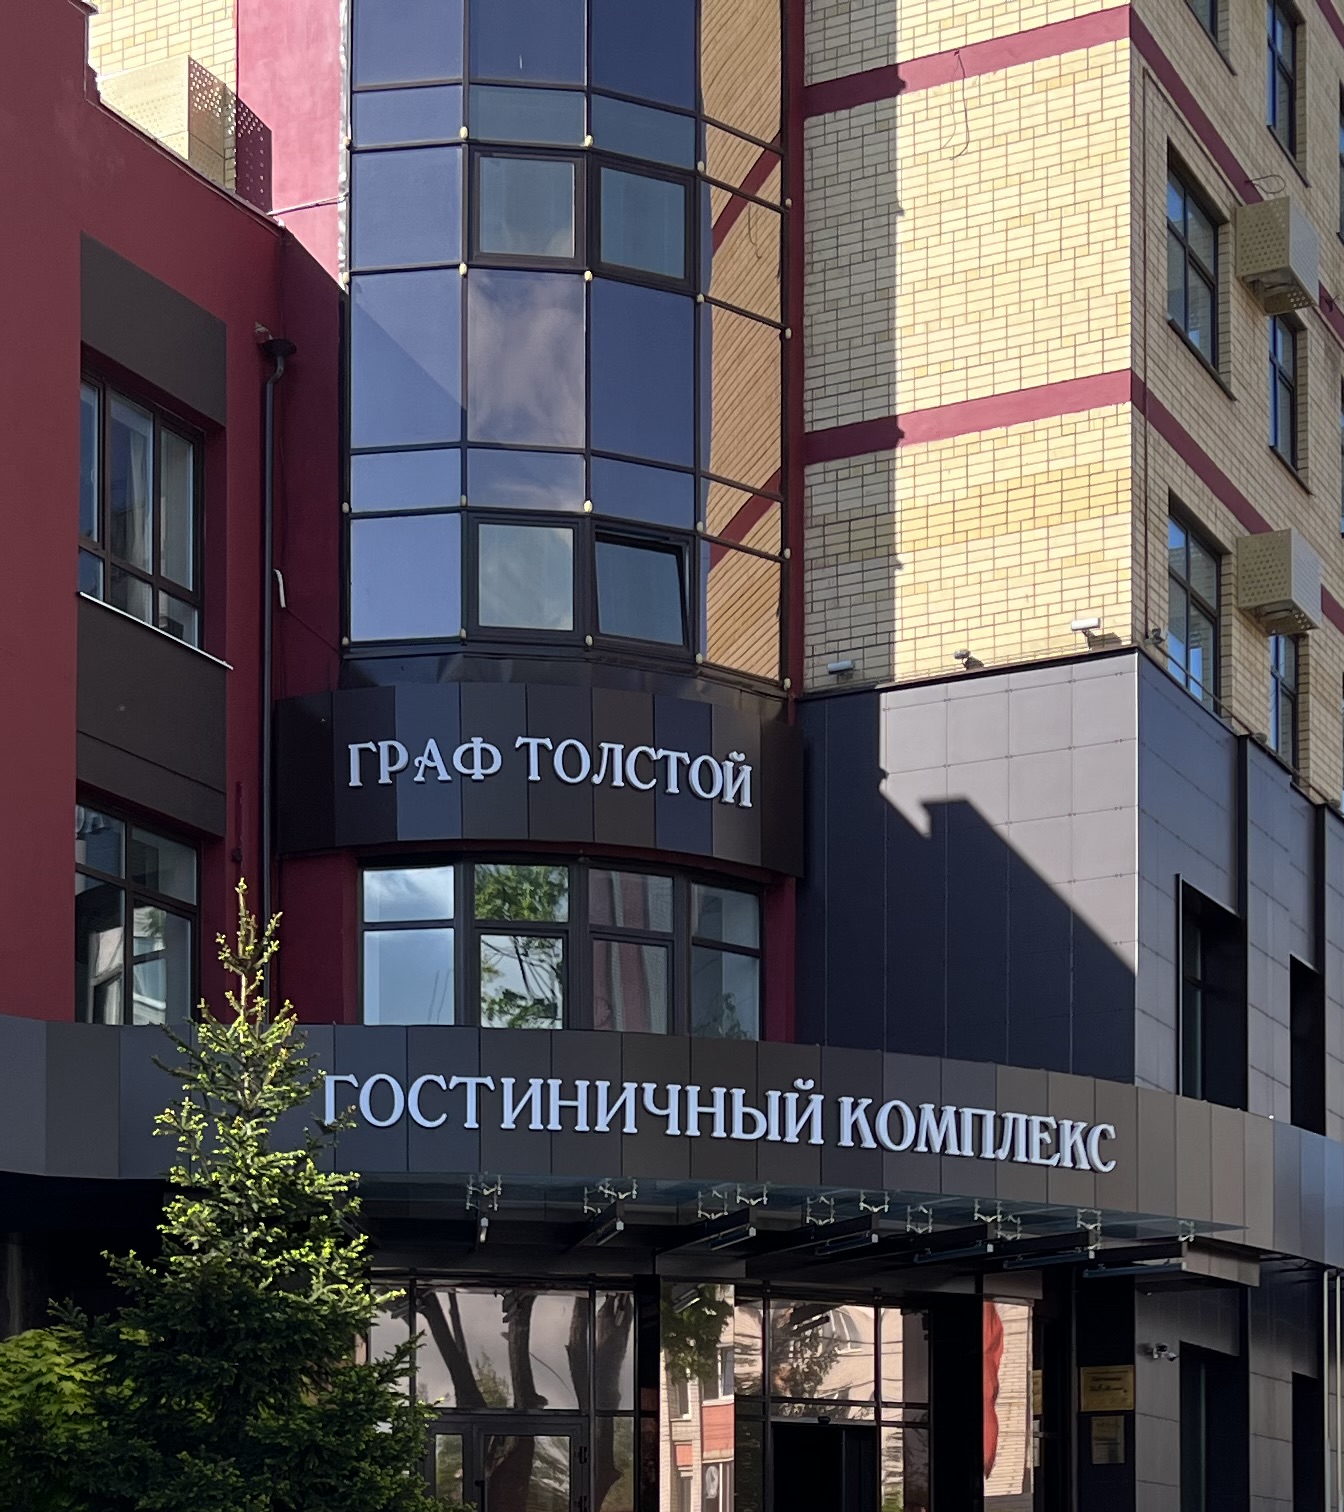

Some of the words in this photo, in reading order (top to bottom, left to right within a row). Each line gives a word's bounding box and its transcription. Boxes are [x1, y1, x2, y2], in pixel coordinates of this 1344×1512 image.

[348, 737, 502, 787] ГРАФ
[515, 735, 753, 808] ТОЛСТОЙ
[323, 1073, 825, 1145] ГОСТИНИЧНЫЙ
[838, 1094, 1118, 1173] КОМПЛЕКС
